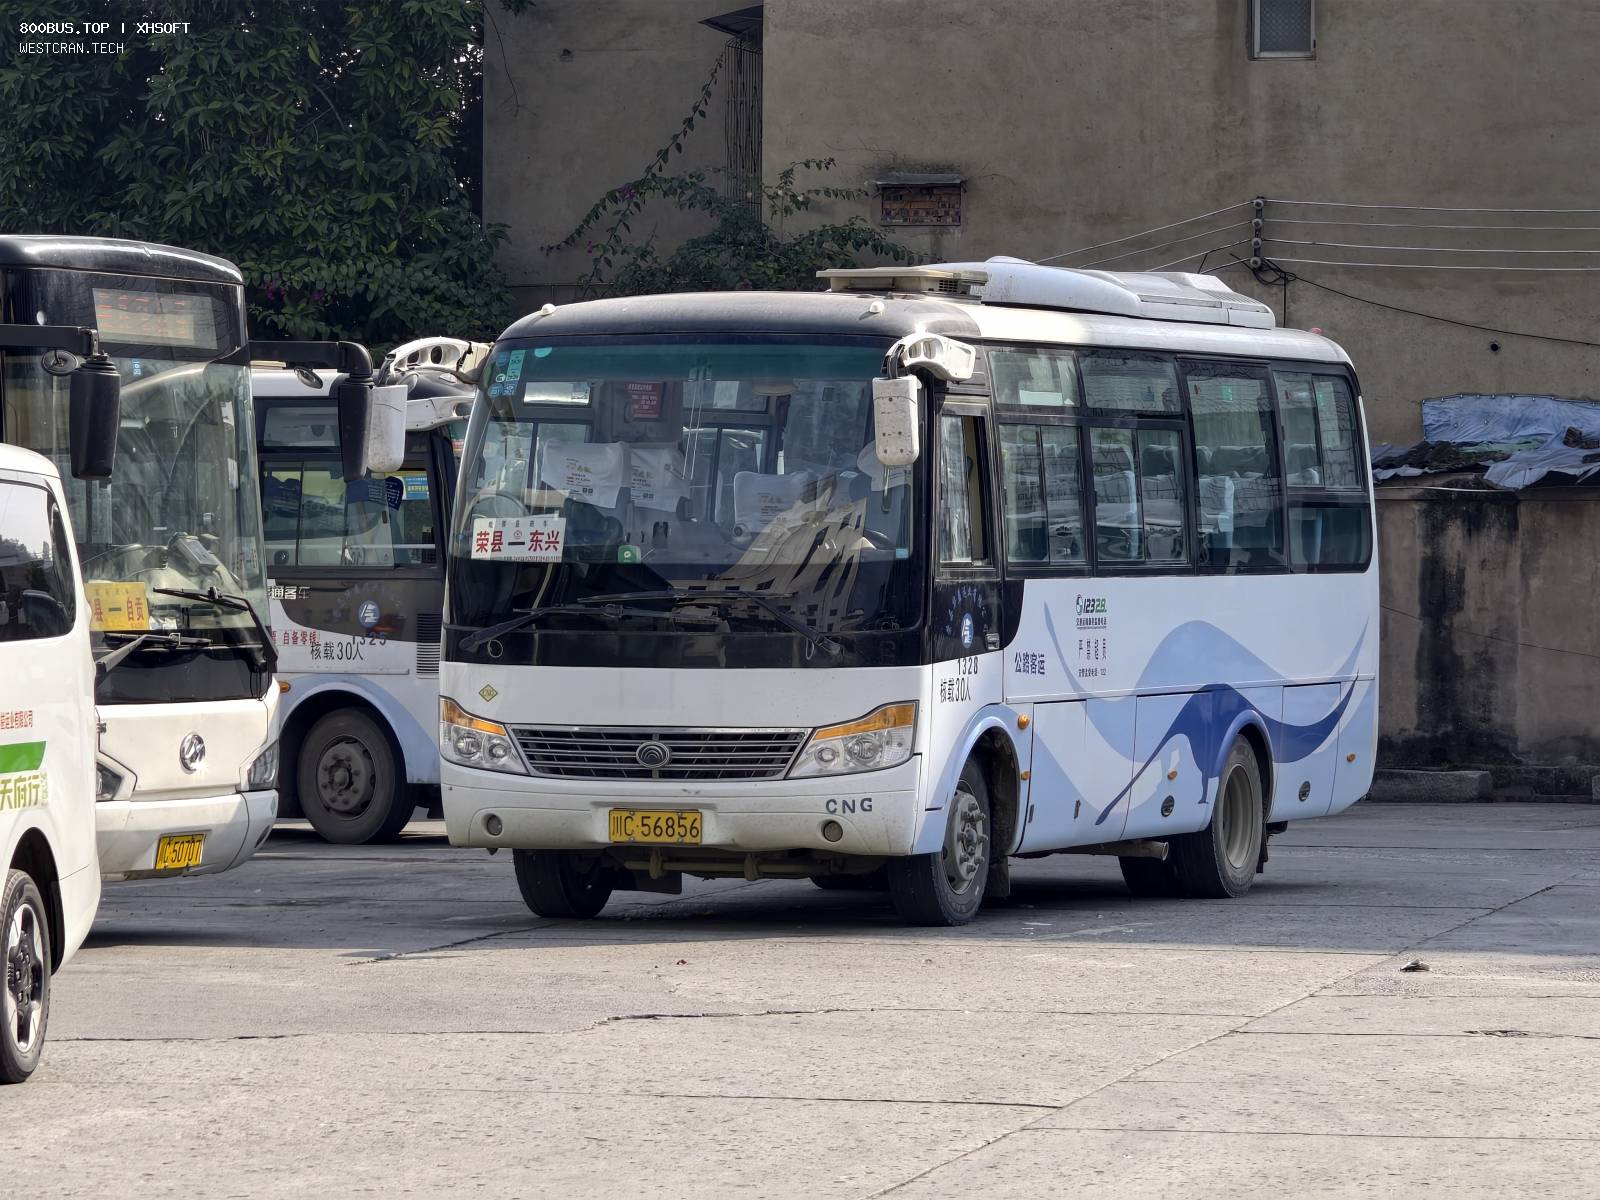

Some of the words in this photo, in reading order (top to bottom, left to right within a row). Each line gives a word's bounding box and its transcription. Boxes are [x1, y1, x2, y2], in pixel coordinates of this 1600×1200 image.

[310, 641, 364, 661] 核载30人
[957, 656, 979, 676] 1328
[1014, 651, 1046, 676] 公路客运
[940, 678, 971, 704] 核载30人
[0, 773, 40, 811] 天府行
[825, 797, 873, 815] CNG
